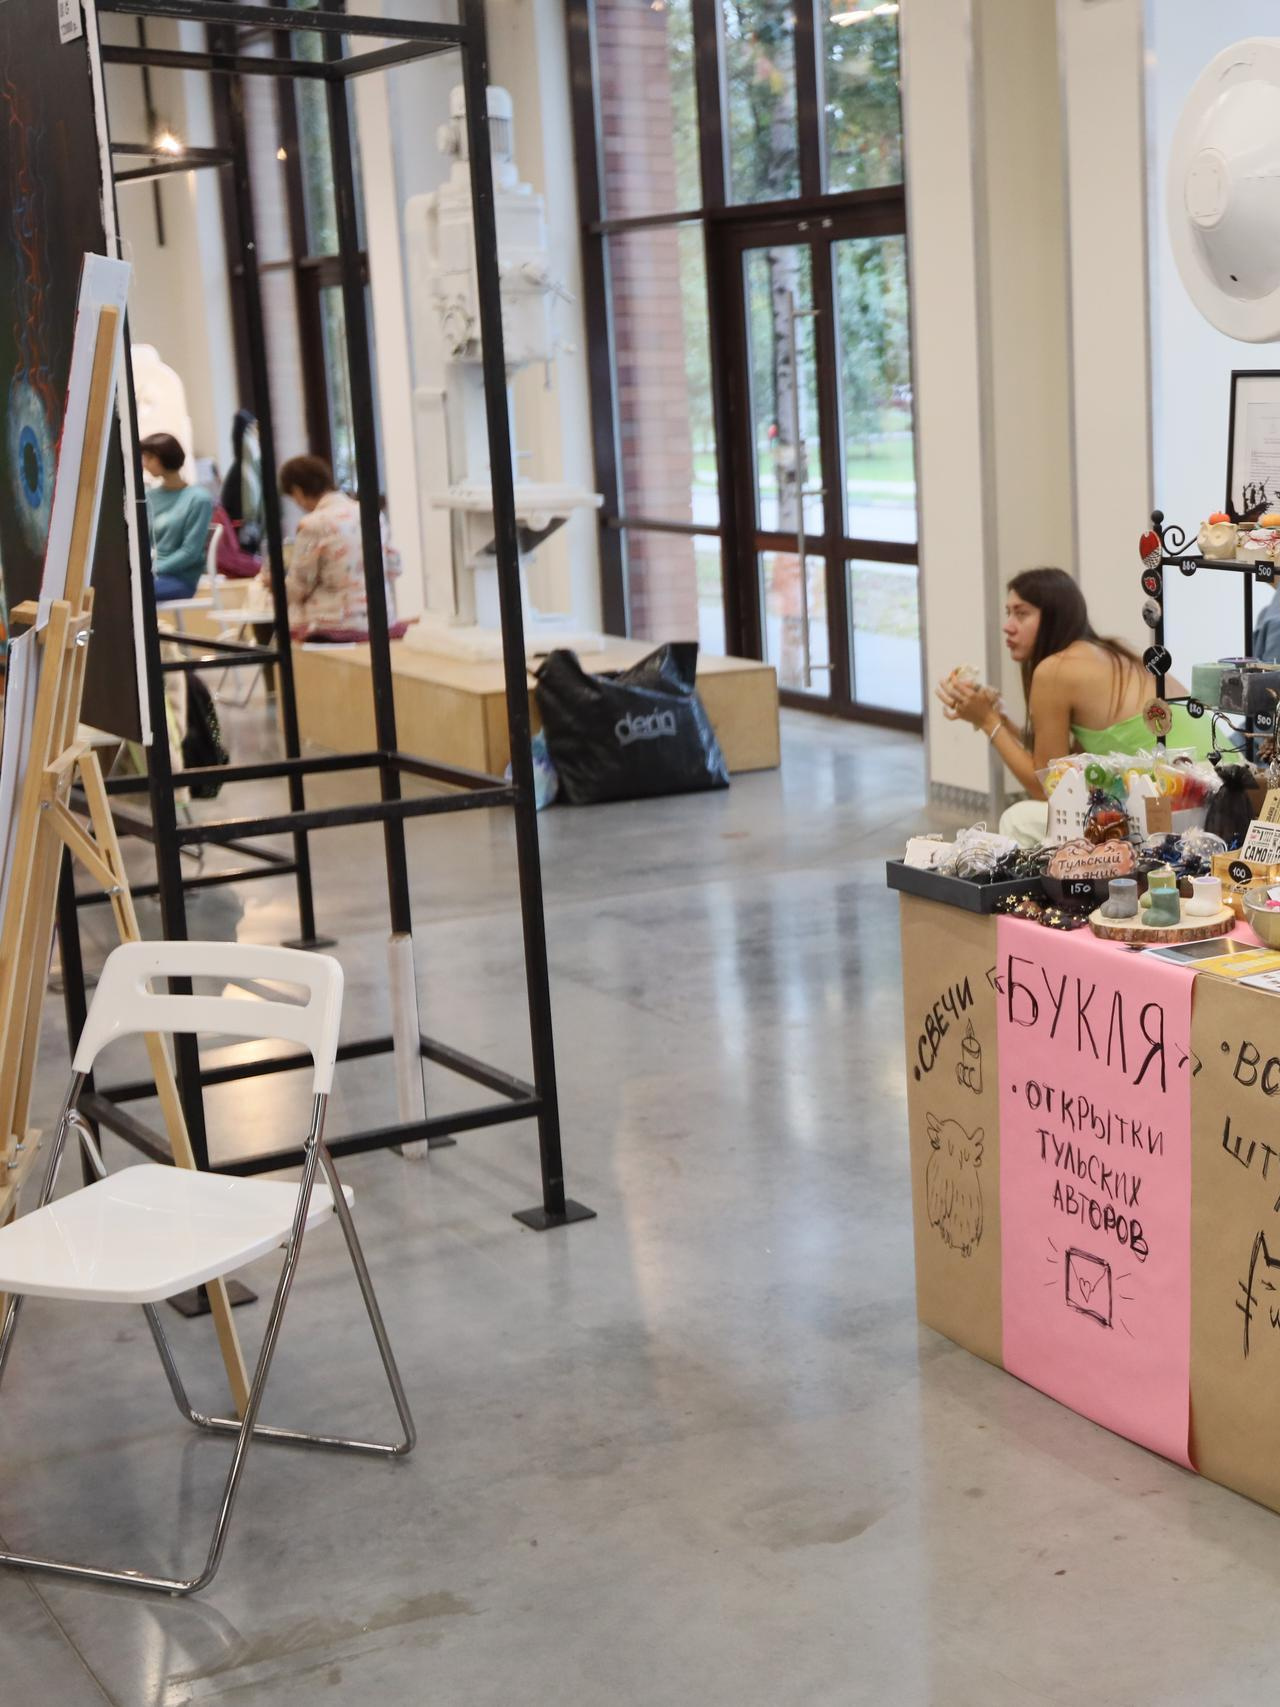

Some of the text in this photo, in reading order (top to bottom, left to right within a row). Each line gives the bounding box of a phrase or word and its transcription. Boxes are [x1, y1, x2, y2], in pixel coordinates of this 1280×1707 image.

[1257, 564, 1272, 577] 500
[615, 707, 677, 746] derin
[1256, 714, 1272, 726] 500
[1058, 852, 1121, 872] Тульский
[1232, 867, 1246, 879] 100
[1070, 883, 1092, 895] 150
[917, 975, 975, 1071] СВЕЧИ
[1027, 1080, 1165, 1157] ОТКРЫТКИ
[1036, 1128, 1143, 1207] ТУЛЬСКИХ
[1052, 1178, 1150, 1263] АВТОРОВ
